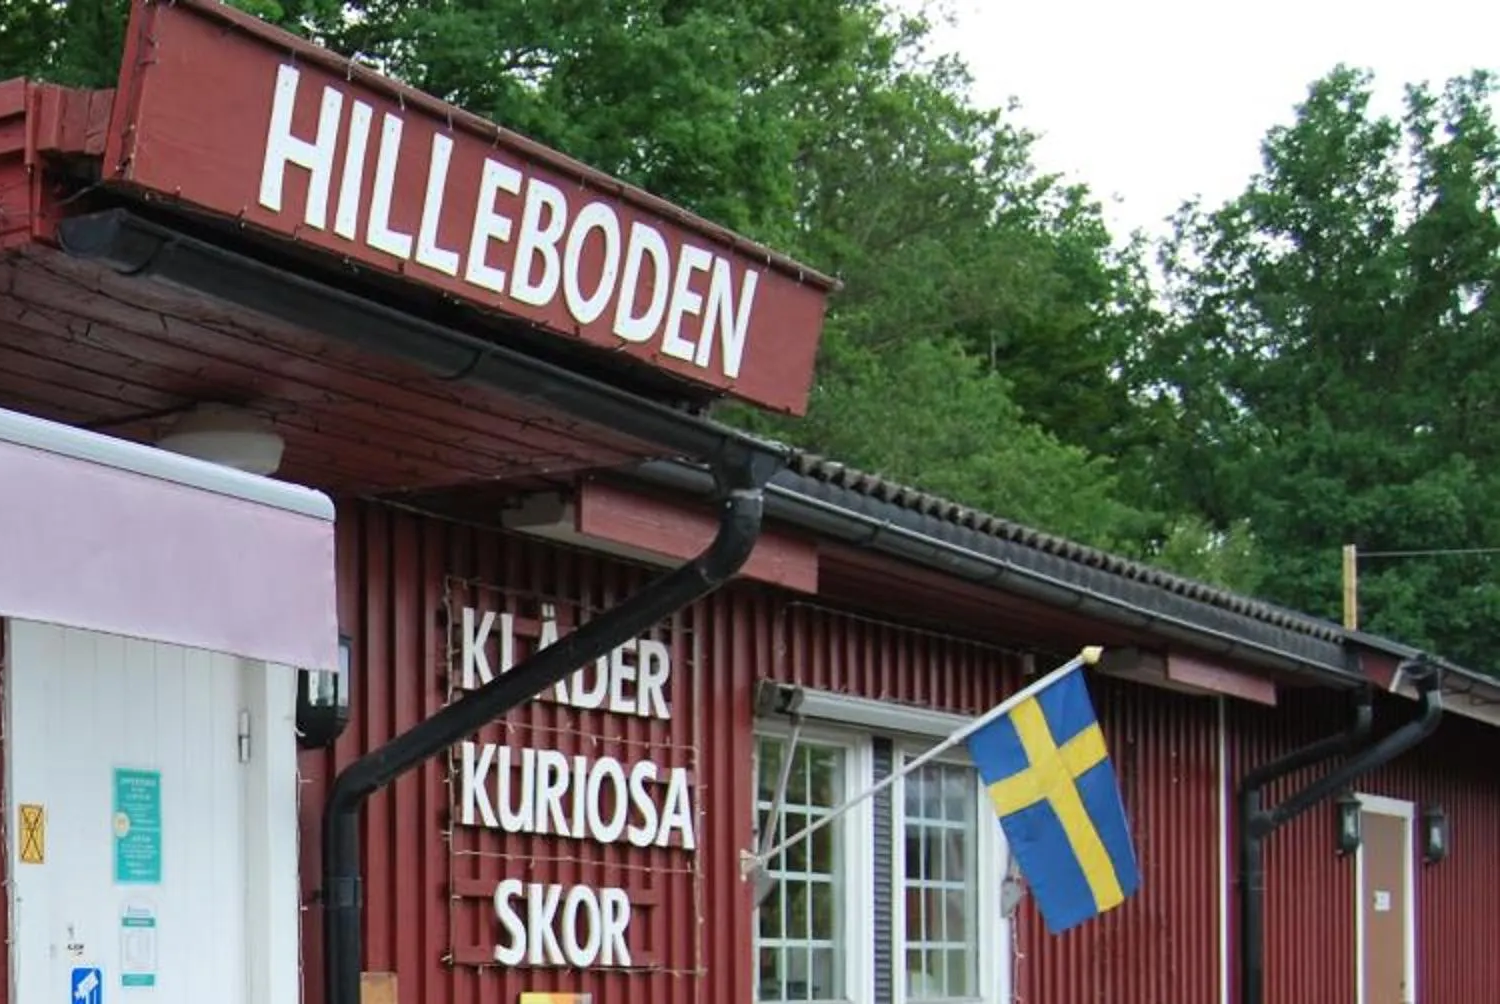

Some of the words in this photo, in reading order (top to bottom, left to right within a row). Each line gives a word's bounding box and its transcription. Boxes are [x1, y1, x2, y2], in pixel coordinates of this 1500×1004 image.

[258, 63, 759, 379] HILLEBODEN
[461, 739, 696, 850] KURIOSA
[493, 877, 633, 968] SKOR
